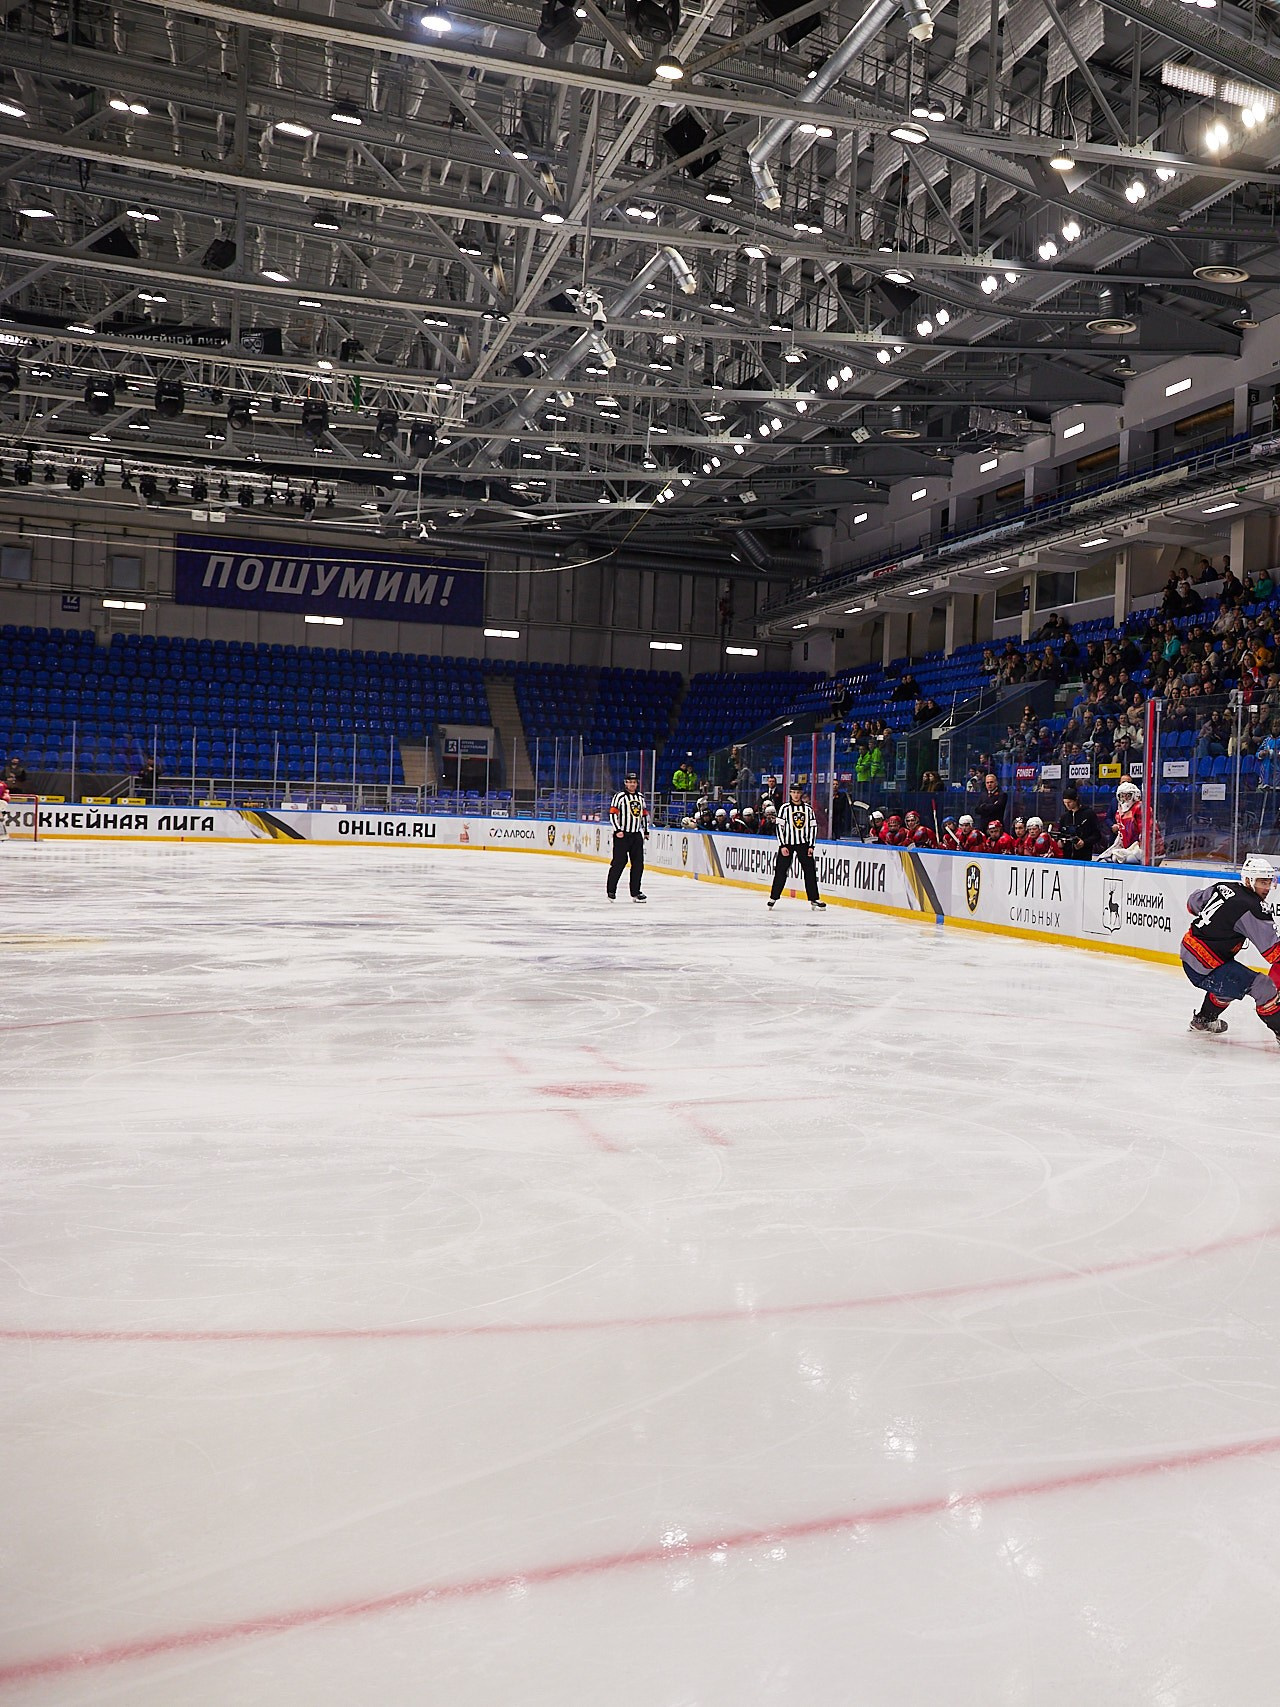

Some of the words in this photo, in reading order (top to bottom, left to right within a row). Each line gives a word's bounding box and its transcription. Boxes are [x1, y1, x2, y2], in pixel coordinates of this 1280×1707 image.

[202, 555, 455, 607] ПОШУМИМ!
[1016, 768, 1035, 777] FONBET
[5, 808, 148, 830] ХОККЕЙНАЯ
[158, 815, 214, 831] ЛИГА
[338, 819, 436, 838] OHLIGA.RU
[725, 846, 777, 876] ОФИЦЕРСКА
[855, 861, 886, 892] ЛИГА
[1008, 866, 1062, 902] ЛИГА
[1126, 892, 1164, 910] НИЖНИЙ
[1009, 906, 1061, 928] СИЛЬНЫХ
[1126, 911, 1172, 933] НОВГОРОД
